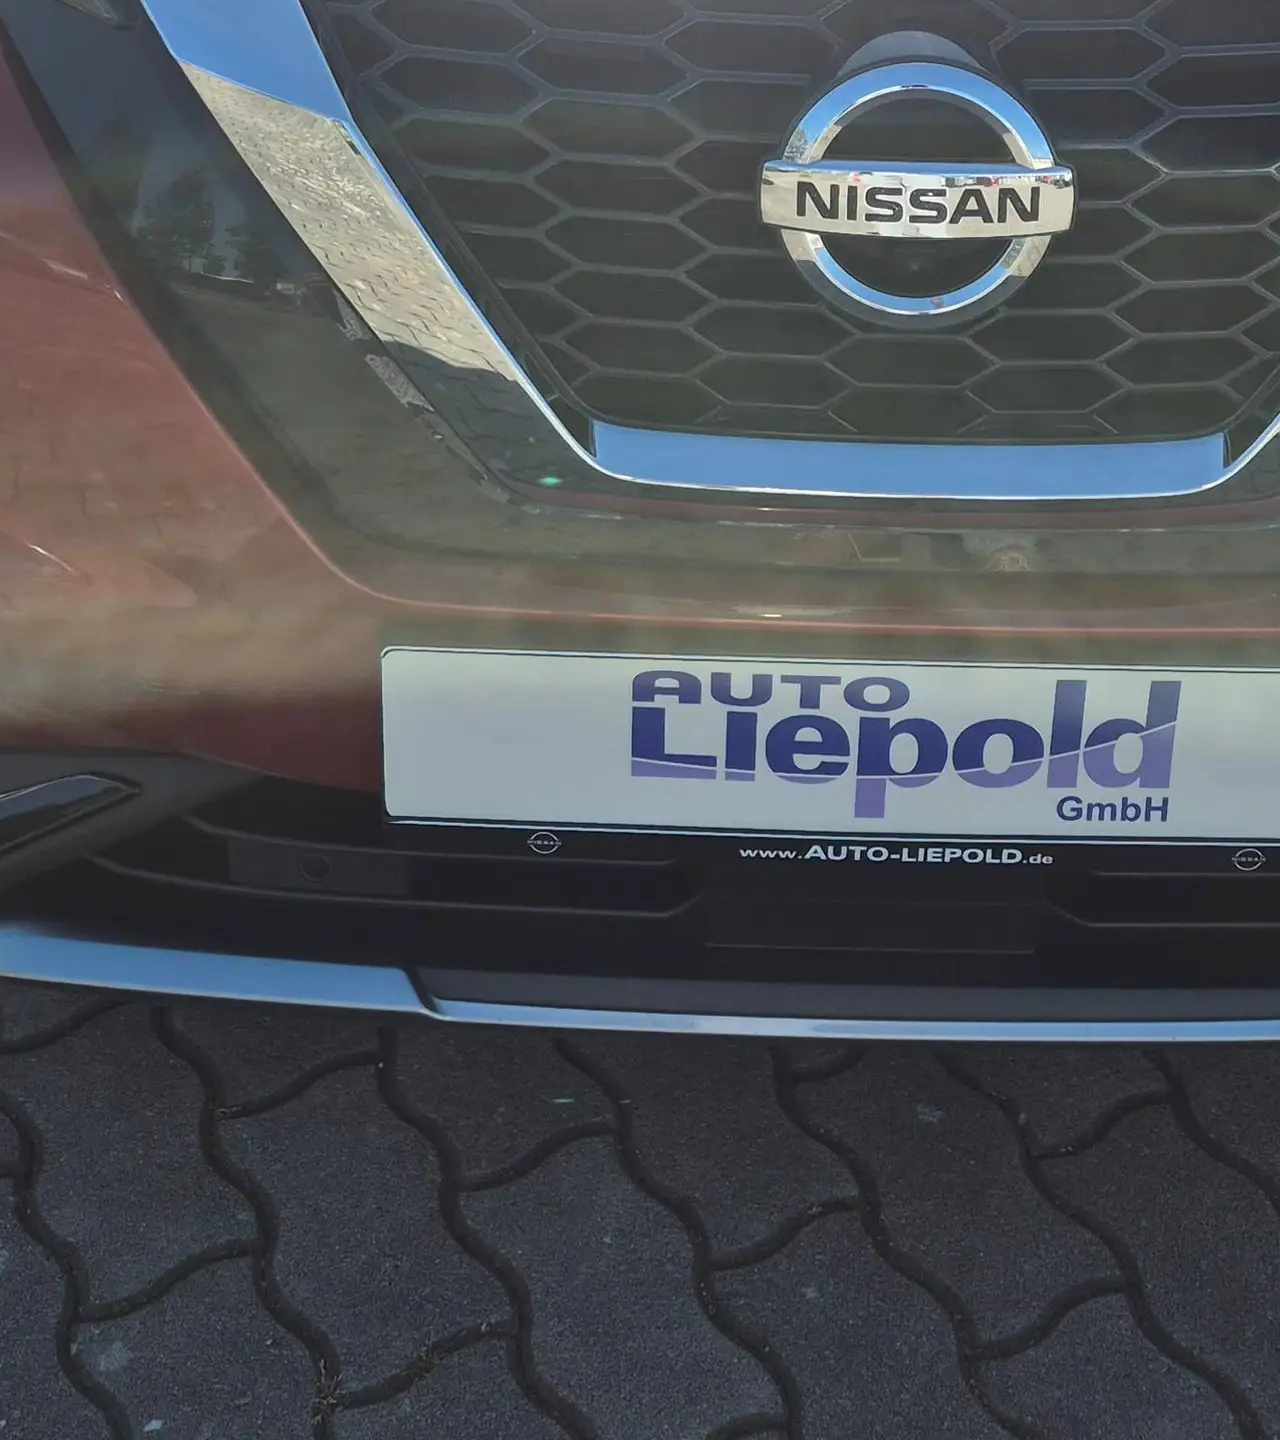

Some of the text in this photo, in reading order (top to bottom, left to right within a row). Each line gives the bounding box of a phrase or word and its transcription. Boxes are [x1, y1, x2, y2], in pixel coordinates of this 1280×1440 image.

[796, 181, 1040, 225] NISSAN
[632, 670, 911, 712] AUTO
[631, 680, 1182, 818] Liepold
[1056, 796, 1169, 822] GmbH
[739, 844, 1053, 865] www.AUTO-LIEPOLD.de
